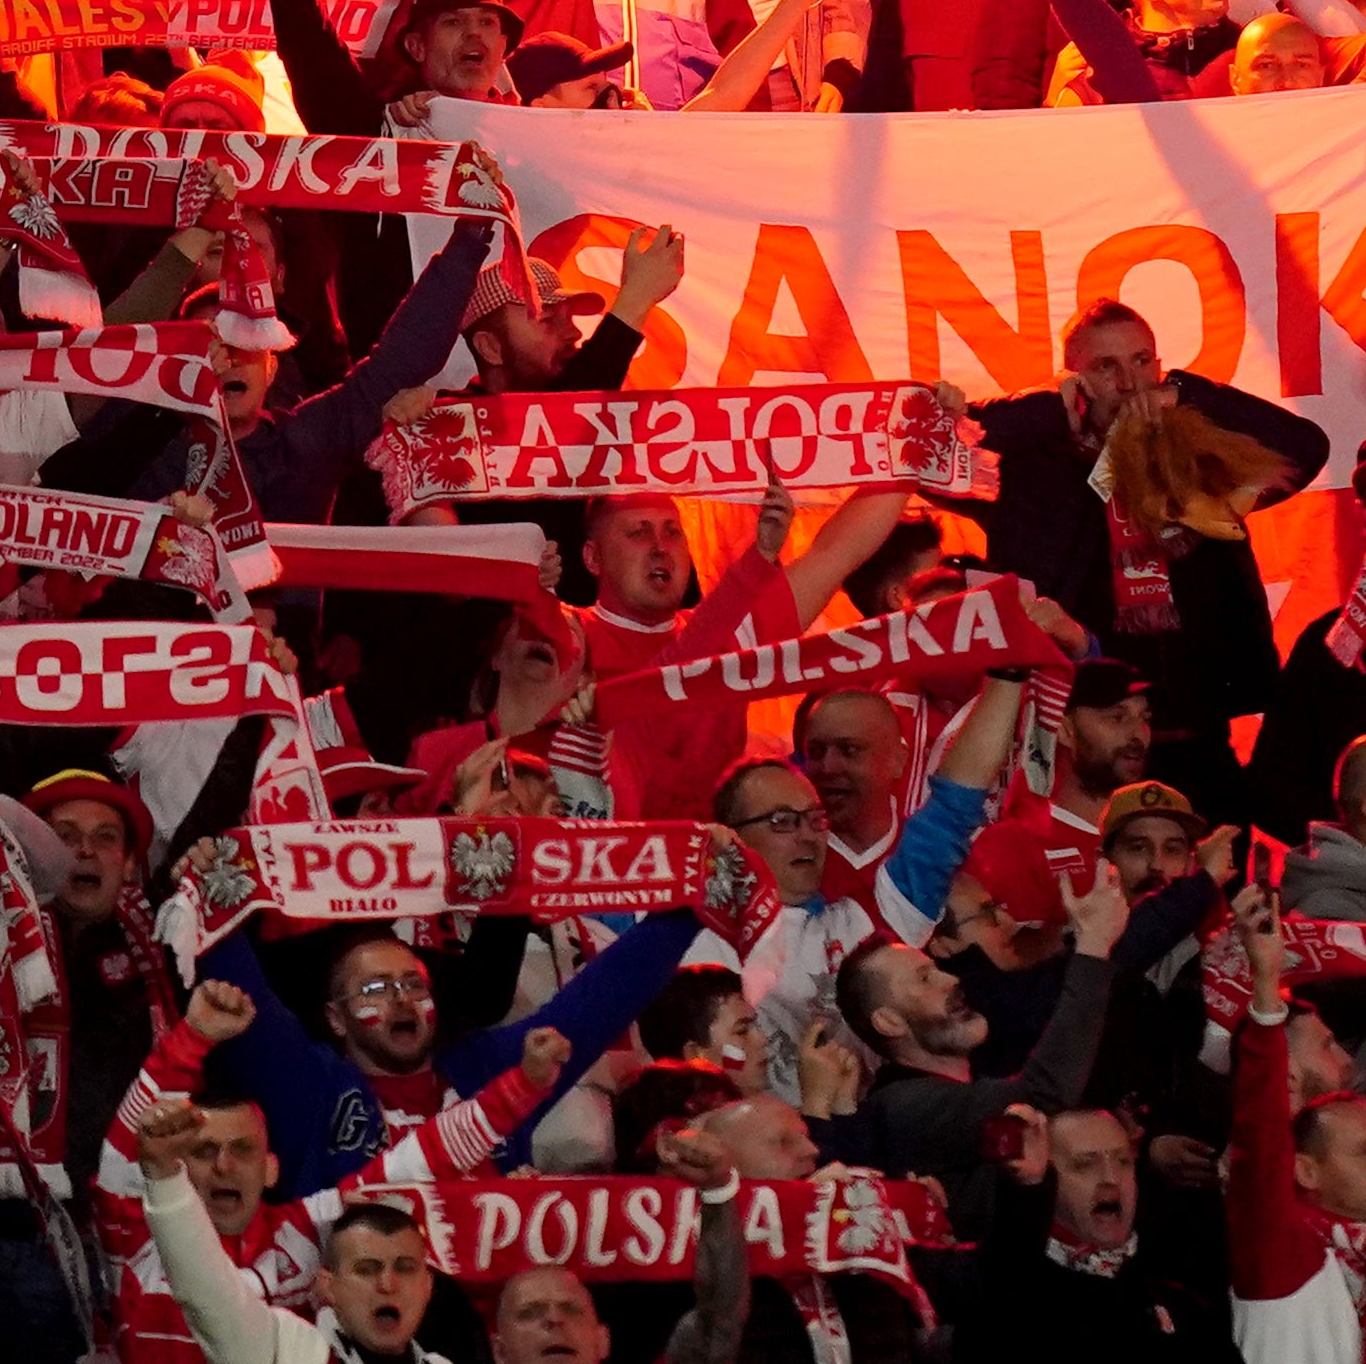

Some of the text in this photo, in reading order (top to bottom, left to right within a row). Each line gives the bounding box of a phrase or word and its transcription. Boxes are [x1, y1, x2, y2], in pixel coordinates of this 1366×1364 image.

[62, 38, 140, 54] STADIUM,
[187, 36, 278, 51] SEPTEMBE
[60, 553, 106, 571] 2022
[662, 591, 1009, 701] POLSKA
[283, 842, 436, 893] POL
[531, 835, 676, 885] SKA
[684, 832, 703, 898] TYLK
[329, 889, 675, 914] BIAŁO CZERWONYM
